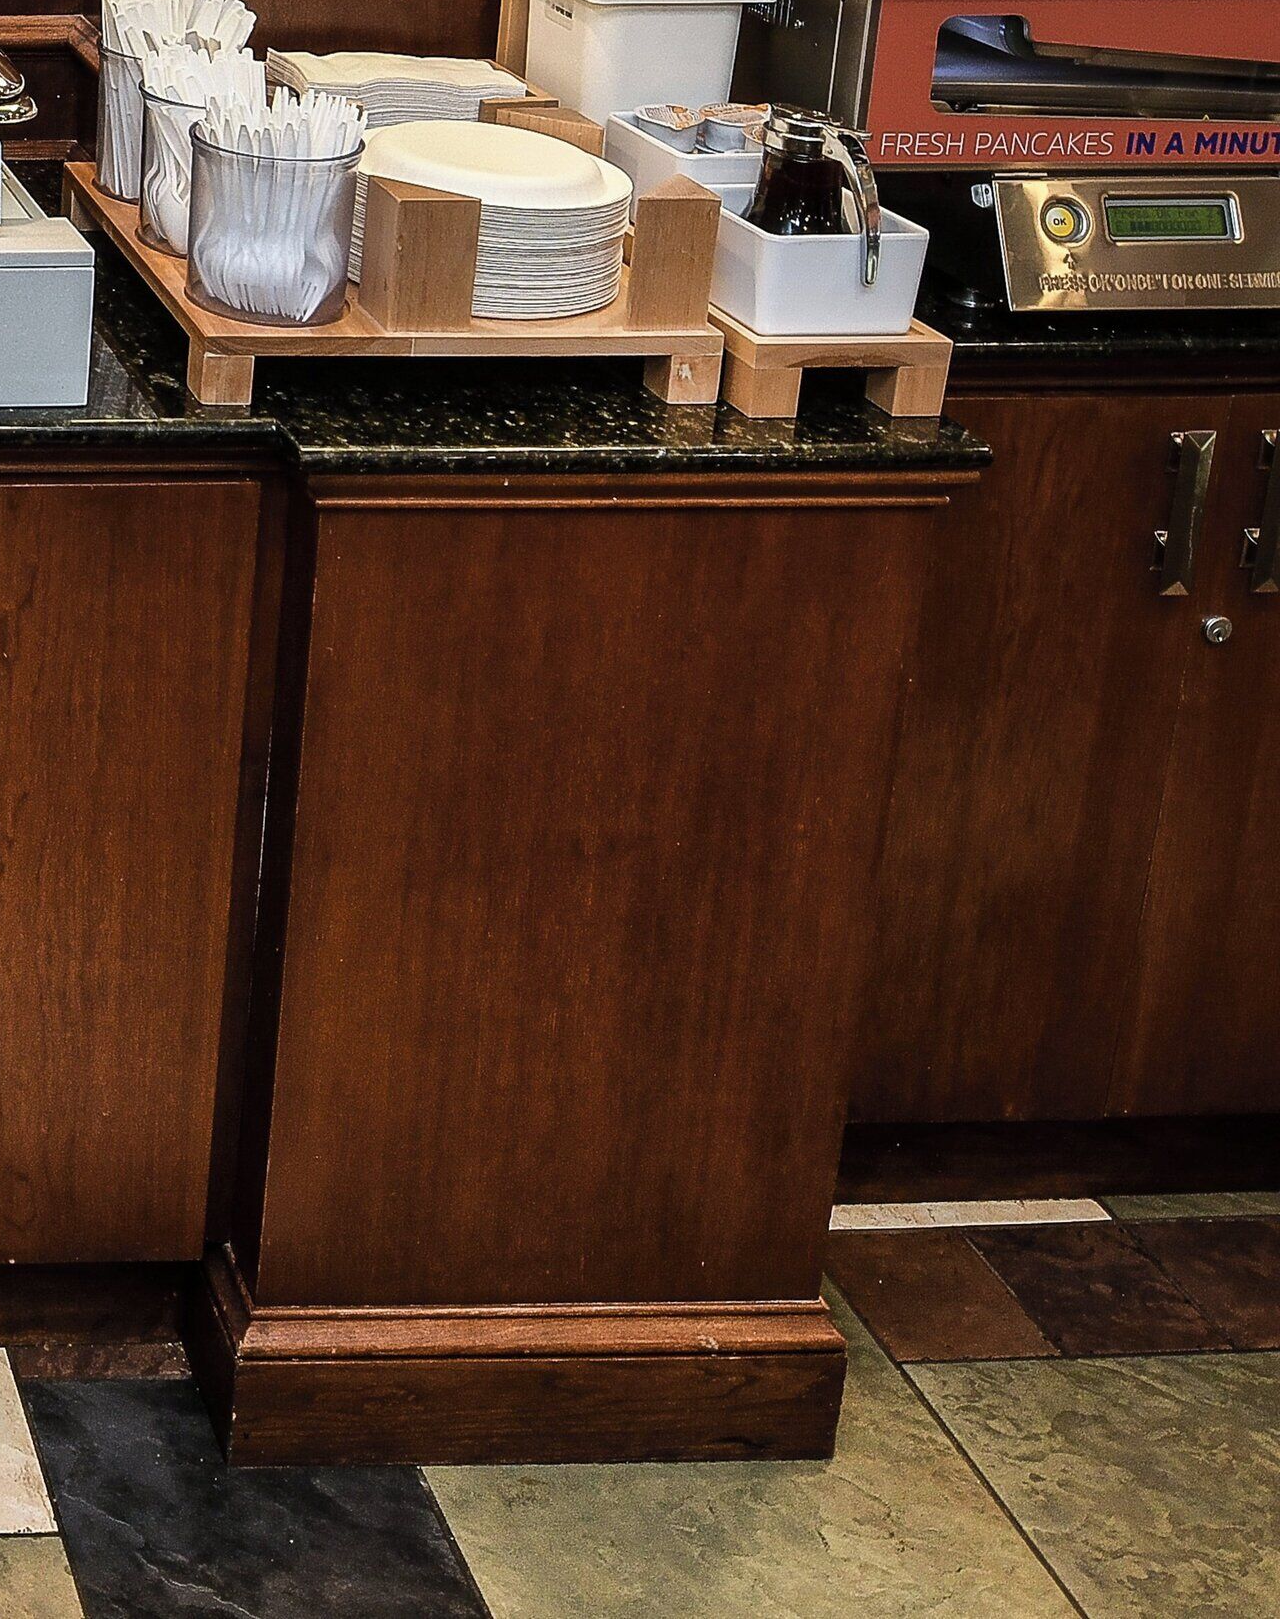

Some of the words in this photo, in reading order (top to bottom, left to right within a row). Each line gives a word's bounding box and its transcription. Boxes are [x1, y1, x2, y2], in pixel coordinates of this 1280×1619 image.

[879, 132, 965, 156] FRESH
[974, 132, 1115, 156] PANCAKES
[1125, 131, 1158, 156] IN
[1163, 131, 1185, 156] A
[1193, 131, 1280, 155] MINUT
[1053, 217, 1067, 226] OK
